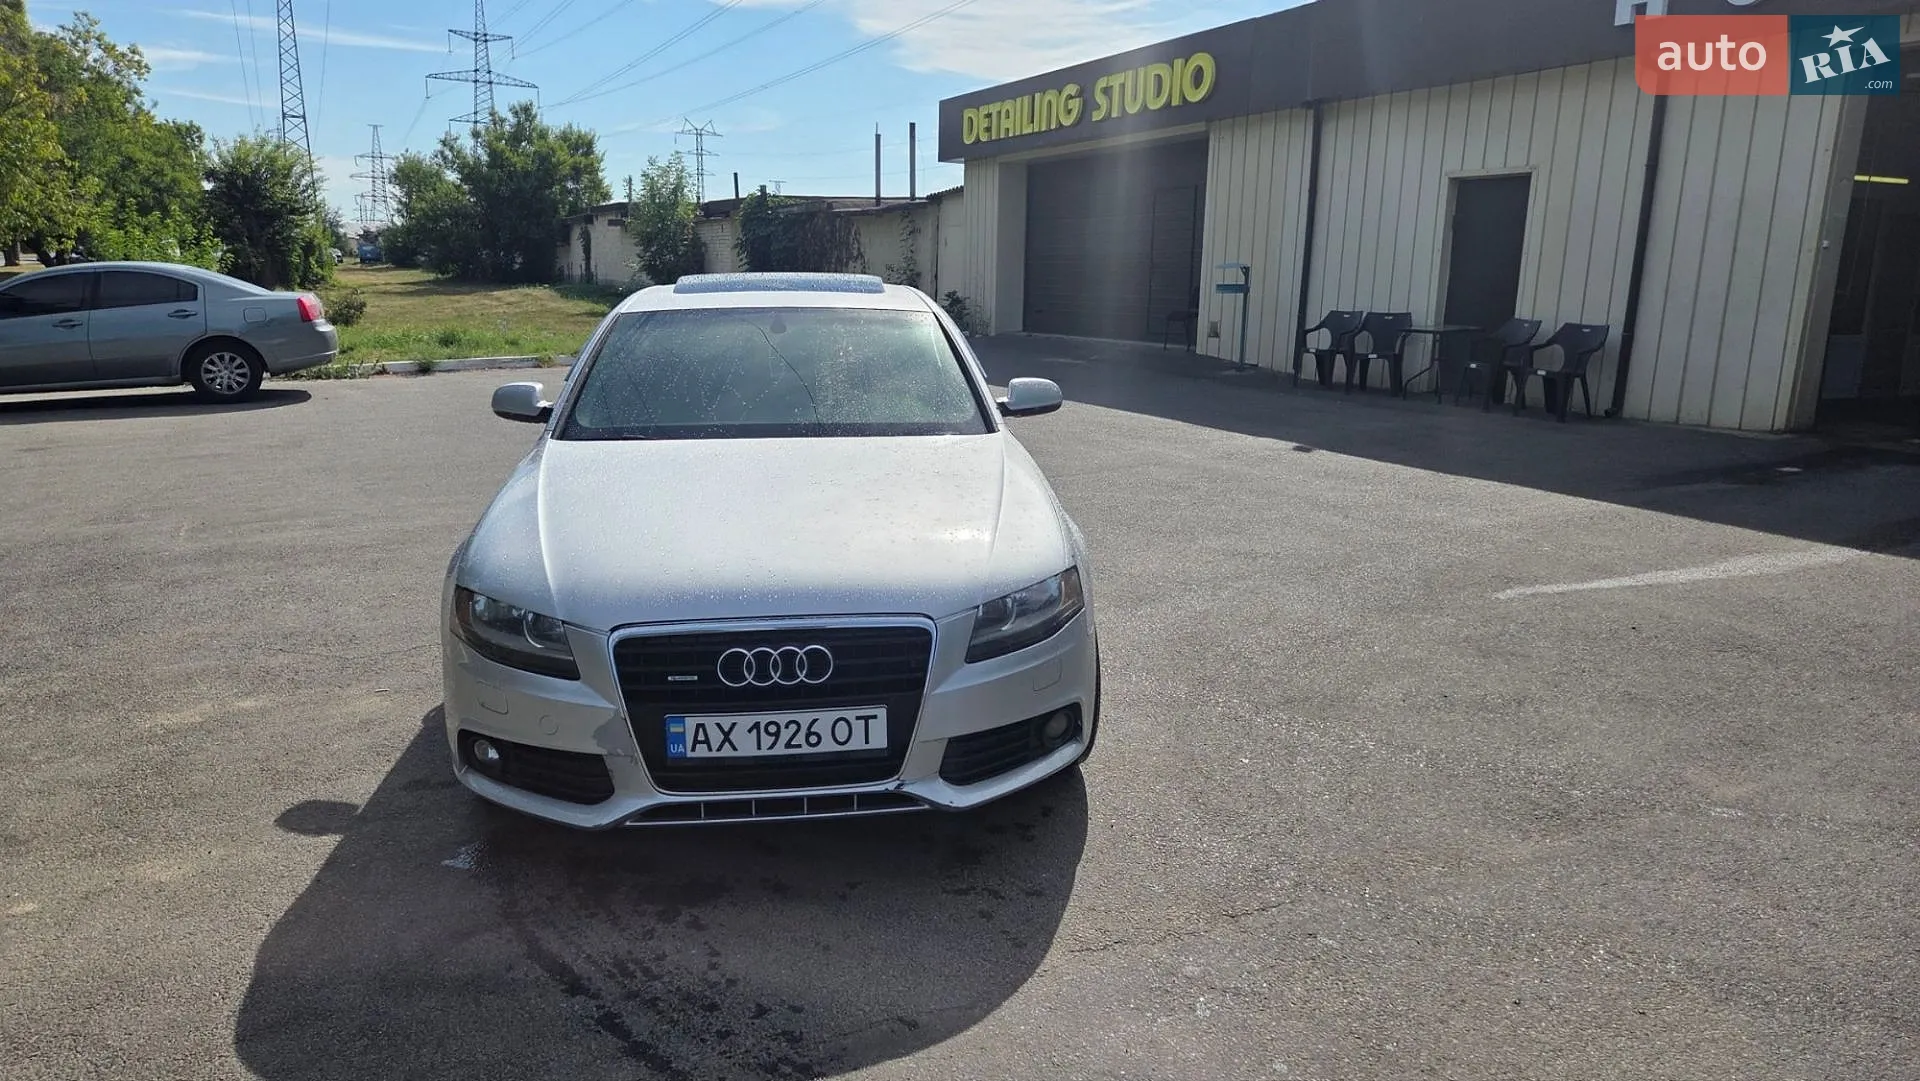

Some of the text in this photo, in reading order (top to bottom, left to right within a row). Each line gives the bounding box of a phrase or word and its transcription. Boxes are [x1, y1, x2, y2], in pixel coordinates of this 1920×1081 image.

[961, 52, 1216, 145] DETAILING STUDIO
[670, 744, 685, 753] UA
[690, 714, 878, 753] AX 1926 OT
